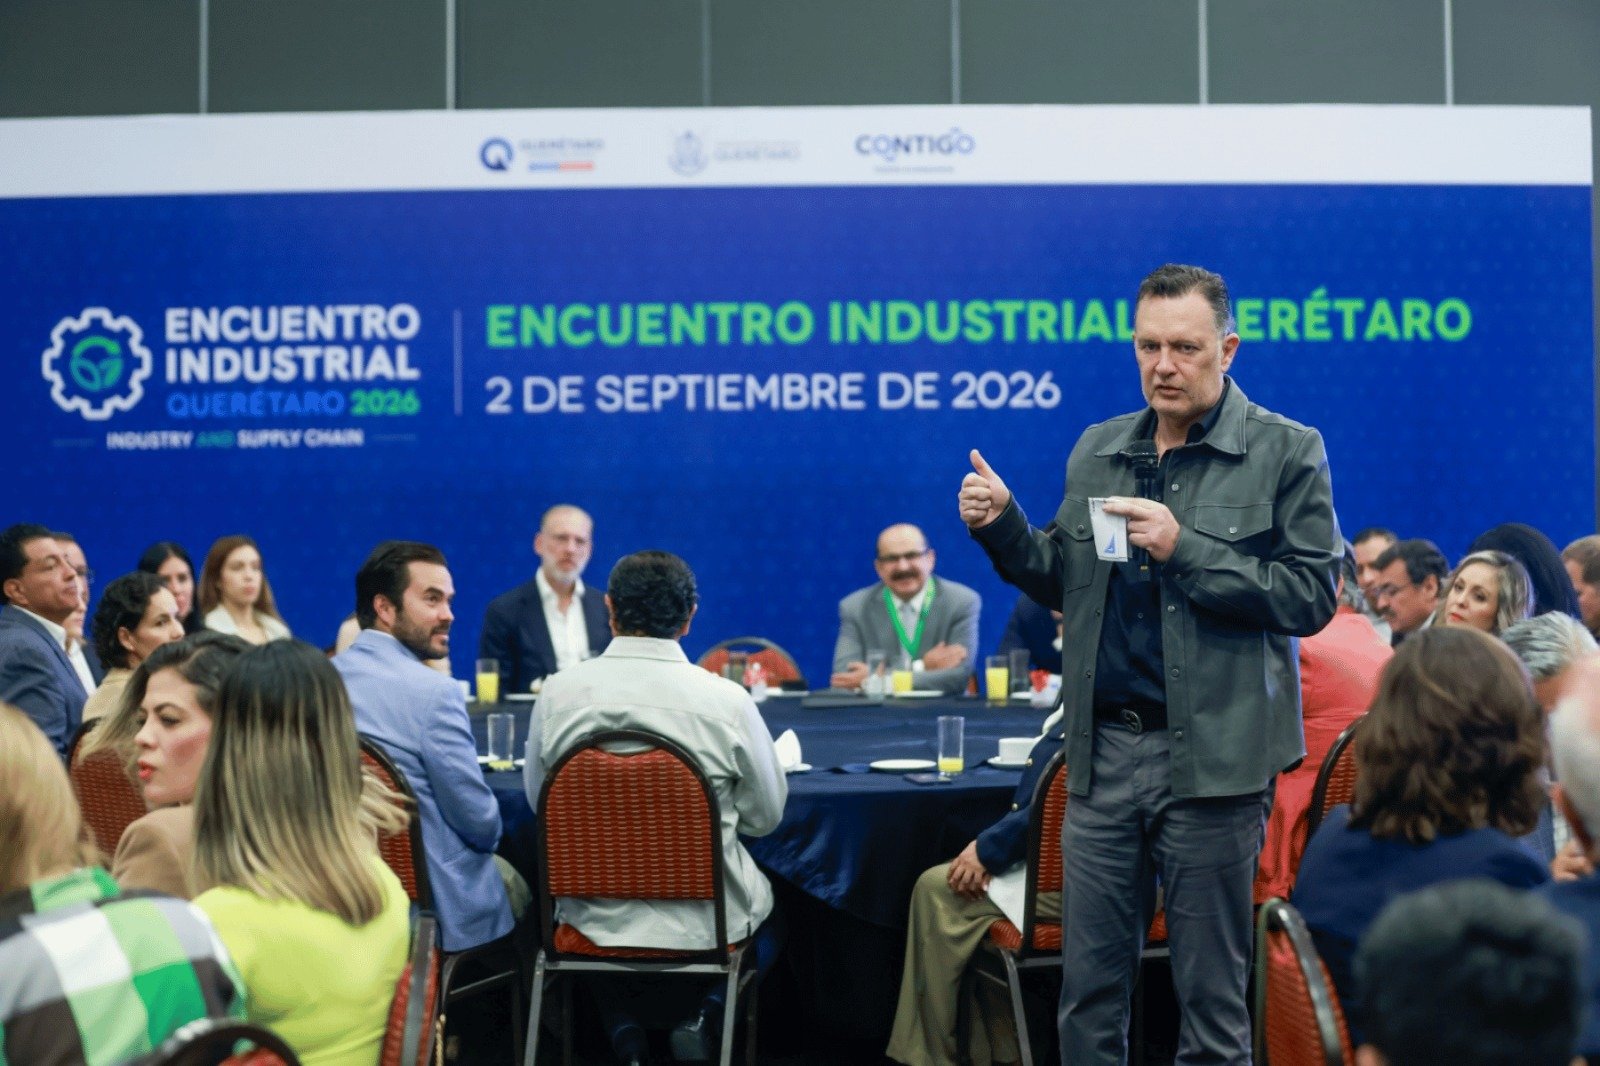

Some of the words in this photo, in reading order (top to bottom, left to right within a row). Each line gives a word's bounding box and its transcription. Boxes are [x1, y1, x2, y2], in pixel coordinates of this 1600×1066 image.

[855, 128, 977, 158] CONTIGO
[165, 304, 420, 343] ENCUENTRO
[486, 302, 814, 347] ENCUENTRO
[829, 298, 1133, 343] INDUSTRIAL
[1236, 286, 1472, 342] ERÉTARO
[165, 345, 420, 383] INDUSTRIAL
[166, 388, 346, 418] QUERÉTARO
[350, 388, 420, 417] 2026
[486, 377, 512, 414] 2
[523, 376, 584, 413] DE
[596, 373, 865, 412] SEPTIEMBRE
[878, 372, 939, 409] DE
[951, 371, 1062, 409] 2026
[106, 431, 193, 450] INDUSTRY
[237, 429, 301, 448] SUPPLY
[304, 428, 364, 447] CHAIN
